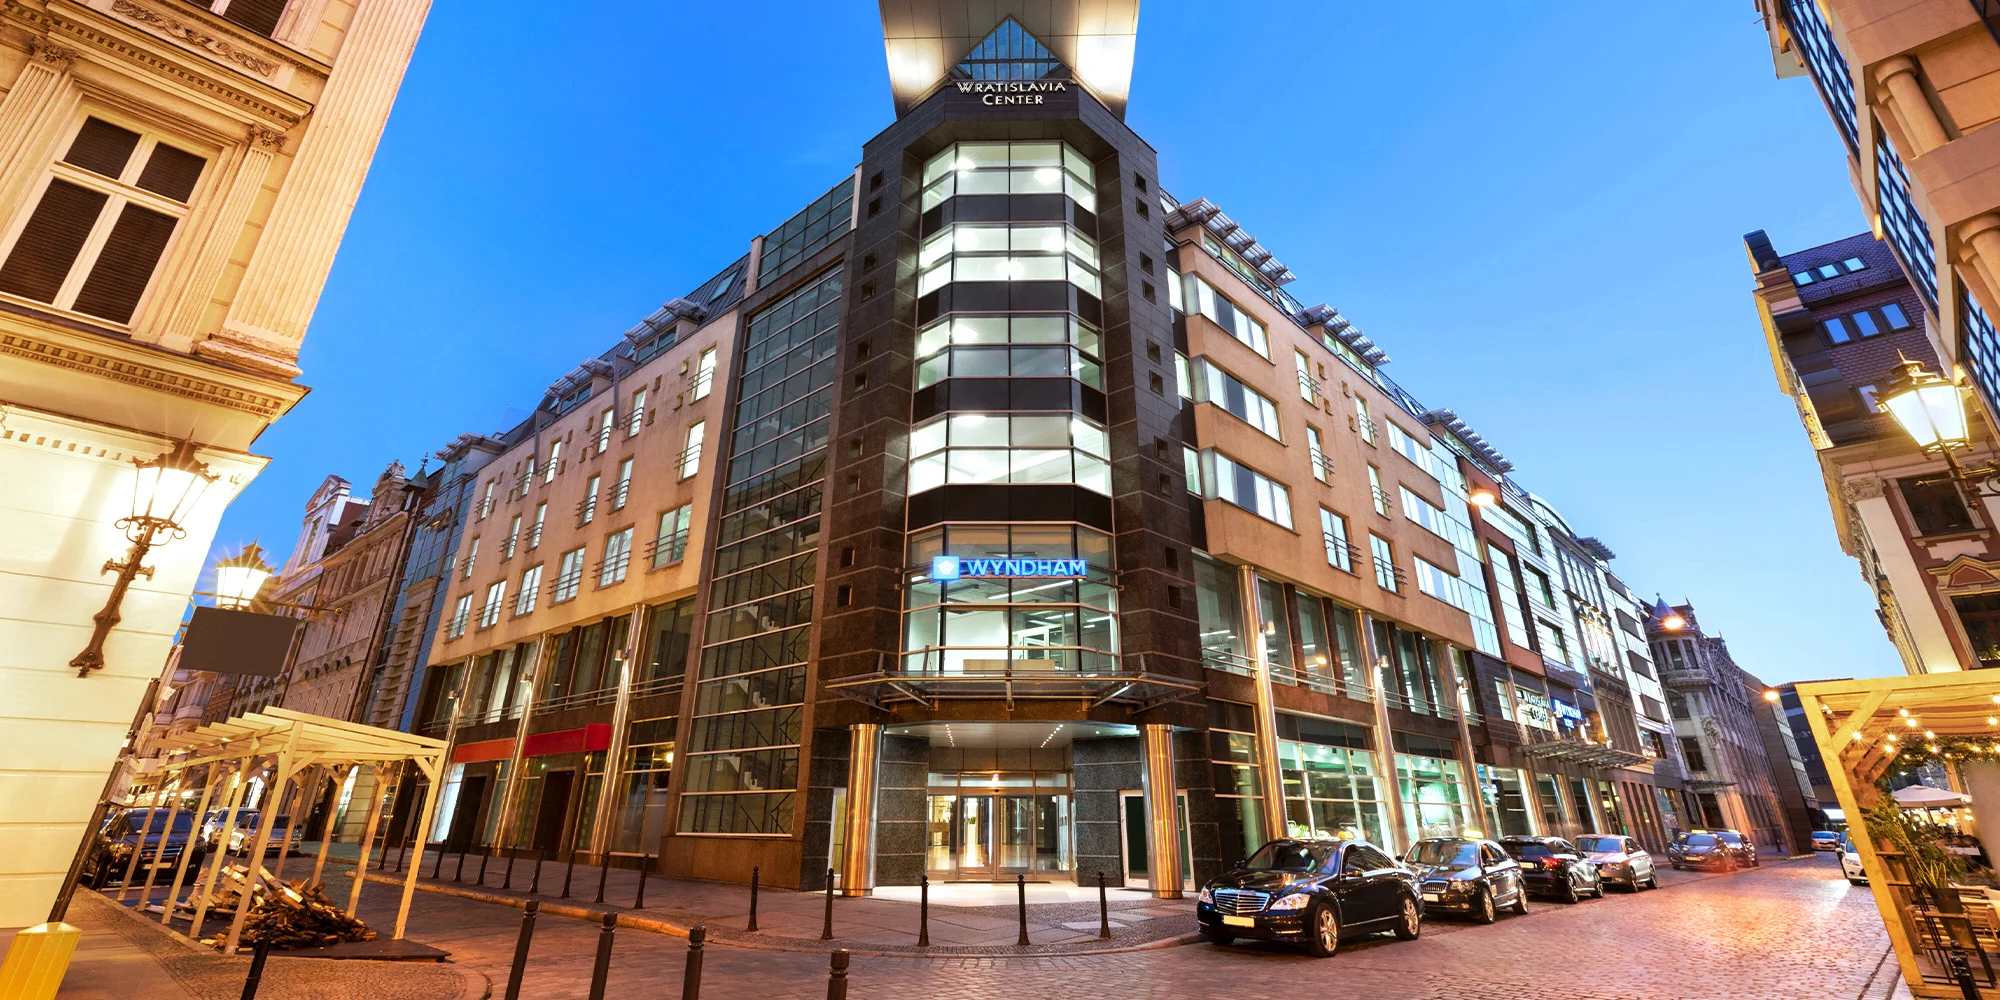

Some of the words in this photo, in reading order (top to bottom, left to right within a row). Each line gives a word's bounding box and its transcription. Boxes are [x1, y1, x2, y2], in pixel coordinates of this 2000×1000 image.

[956, 82, 1066, 93] WRATISLAVIA
[982, 93, 1044, 106] CENTER
[966, 559, 1087, 576] WYNDHAM
